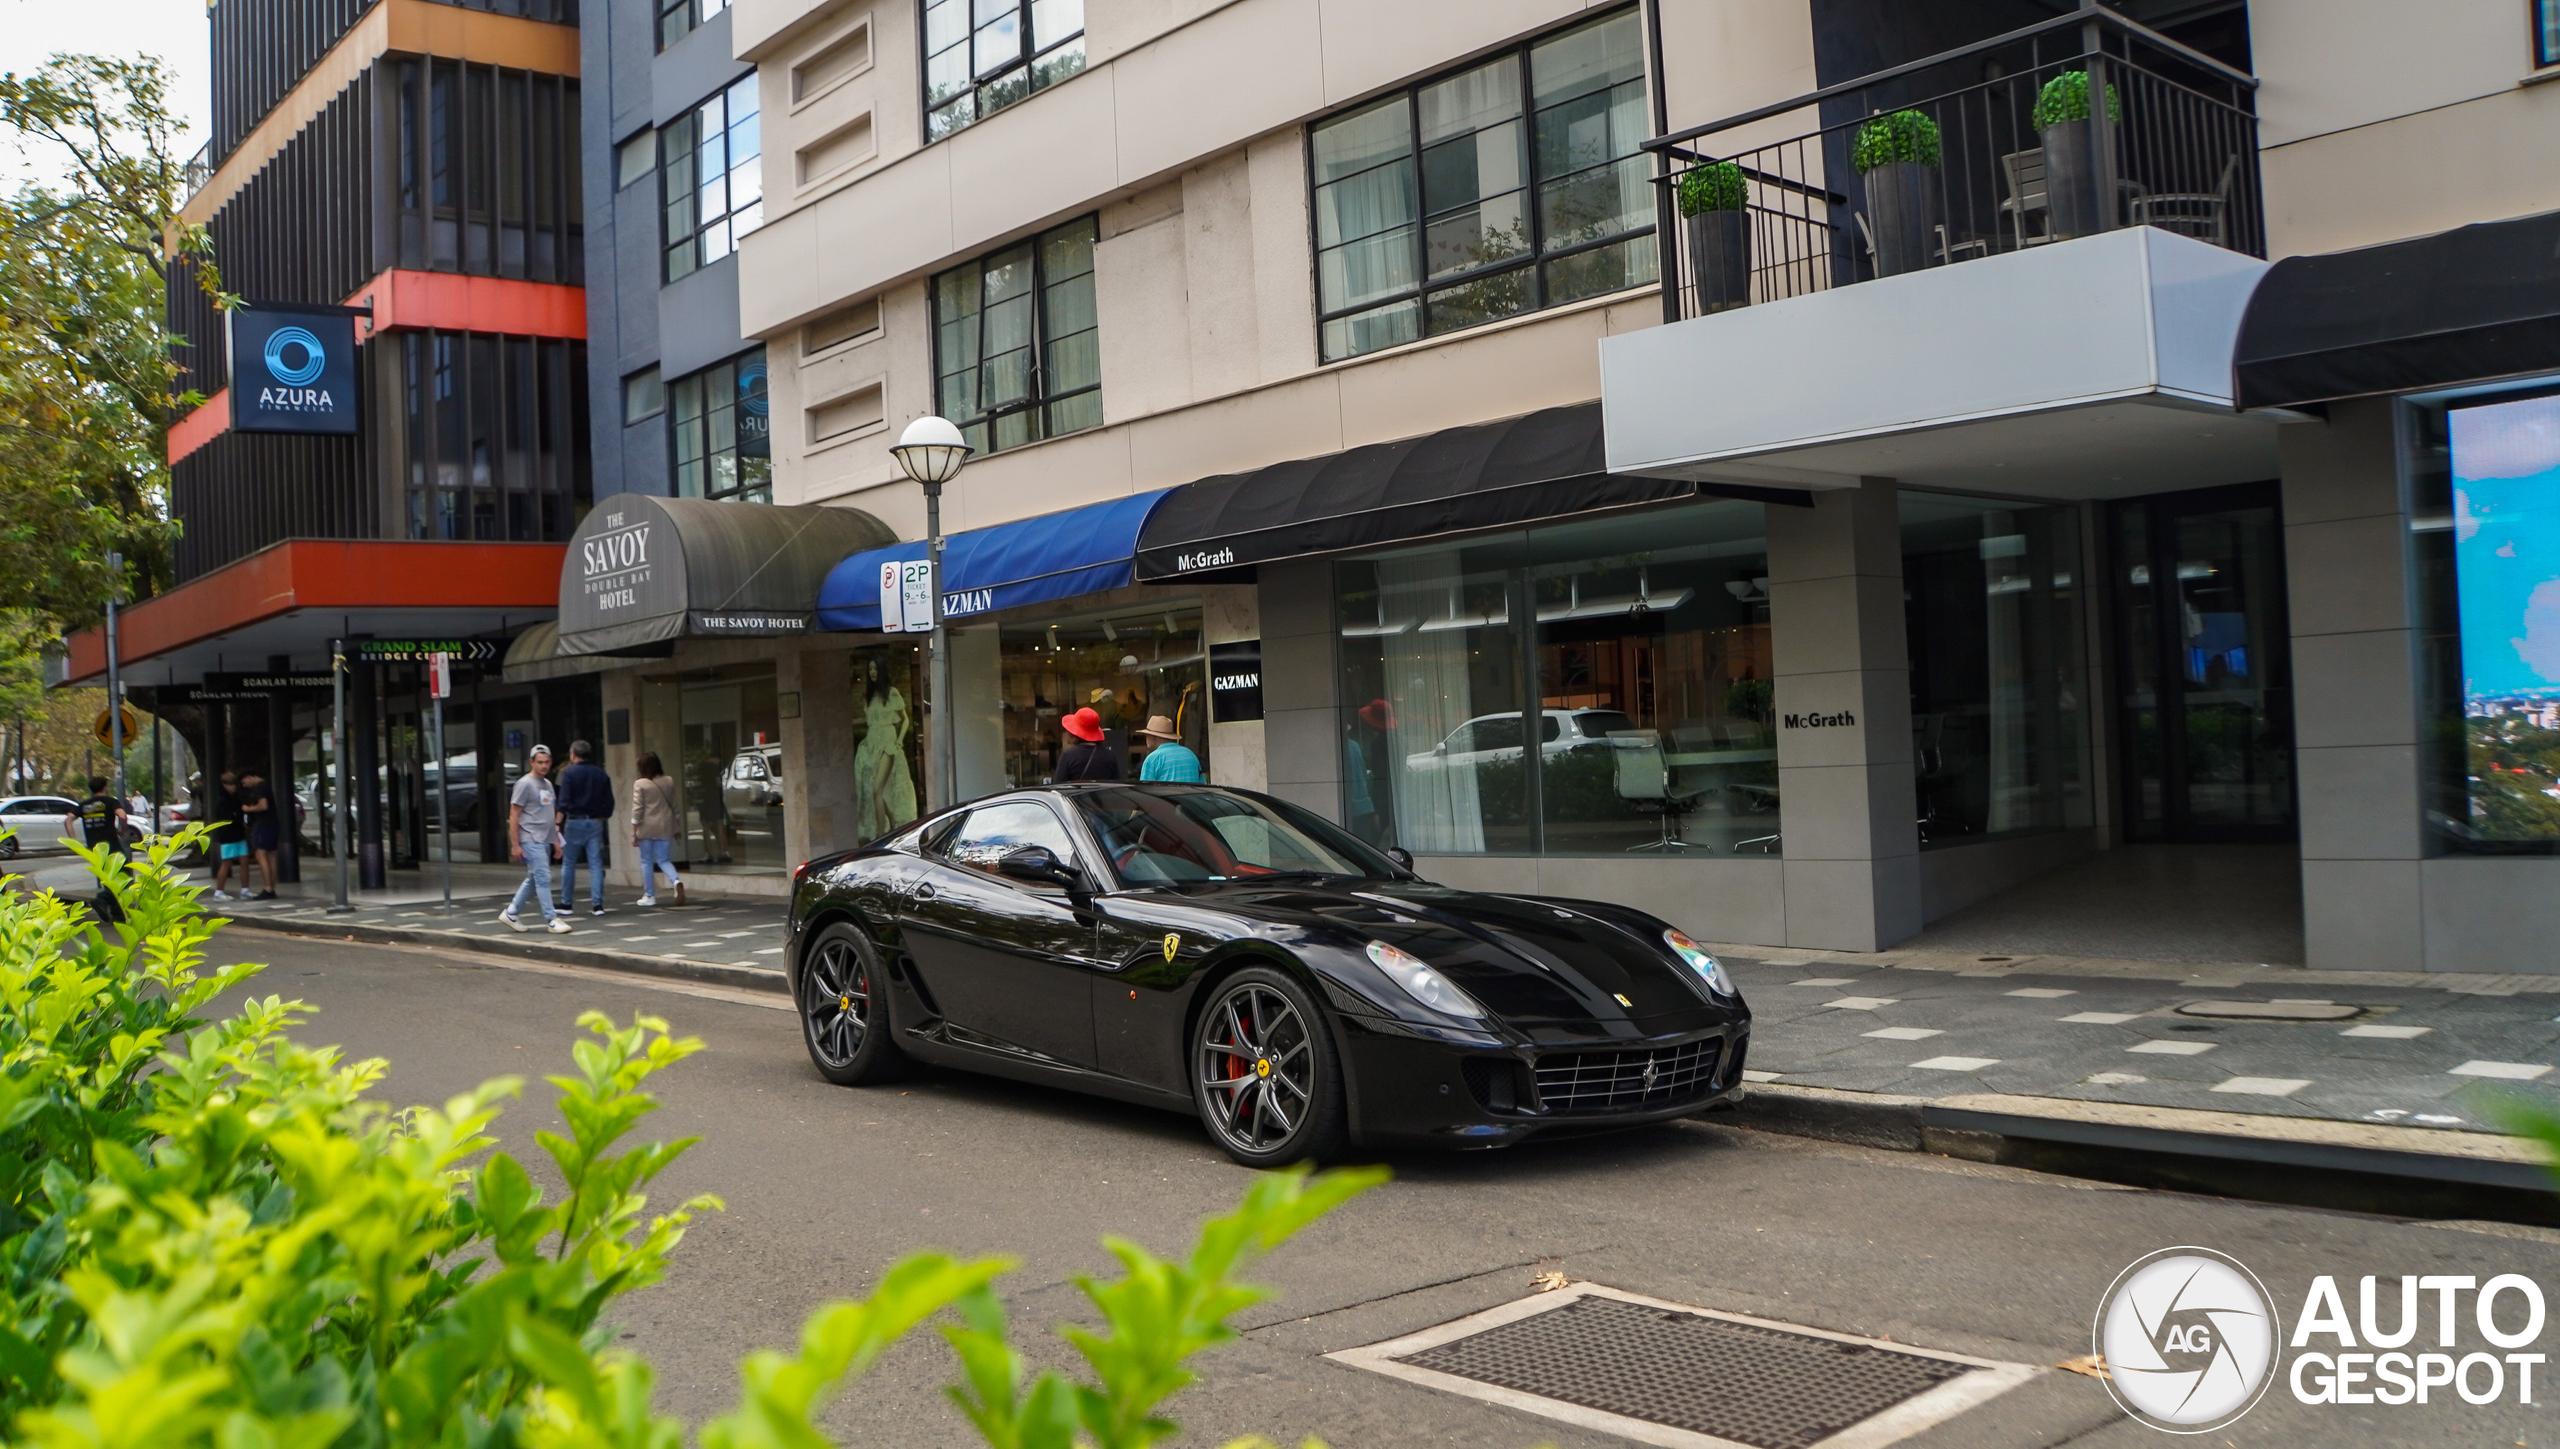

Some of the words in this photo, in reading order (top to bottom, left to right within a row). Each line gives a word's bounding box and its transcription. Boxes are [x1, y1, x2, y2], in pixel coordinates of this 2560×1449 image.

[259, 387, 333, 406] AZURA
[606, 512, 624, 528] THE
[583, 527, 650, 576] SAVOY
[1178, 546, 1234, 571] McGrath
[584, 576, 625, 594] DOUBLE
[630, 570, 651, 584] BAY
[905, 565, 929, 583] 2P
[599, 588, 636, 610] HOTEL
[941, 588, 992, 616] AZMAN
[703, 617, 726, 628] THE
[728, 617, 766, 628] SAVOY
[768, 618, 805, 629] HOTEL
[360, 641, 416, 652] GRAND
[420, 641, 462, 652] SLAM
[360, 652, 410, 661] BRIDGE
[415, 652, 463, 661] CERE
[242, 677, 287, 687] SCANLAN
[1214, 673, 1259, 691] GAZMAN
[1784, 710, 1855, 729] McGrath
